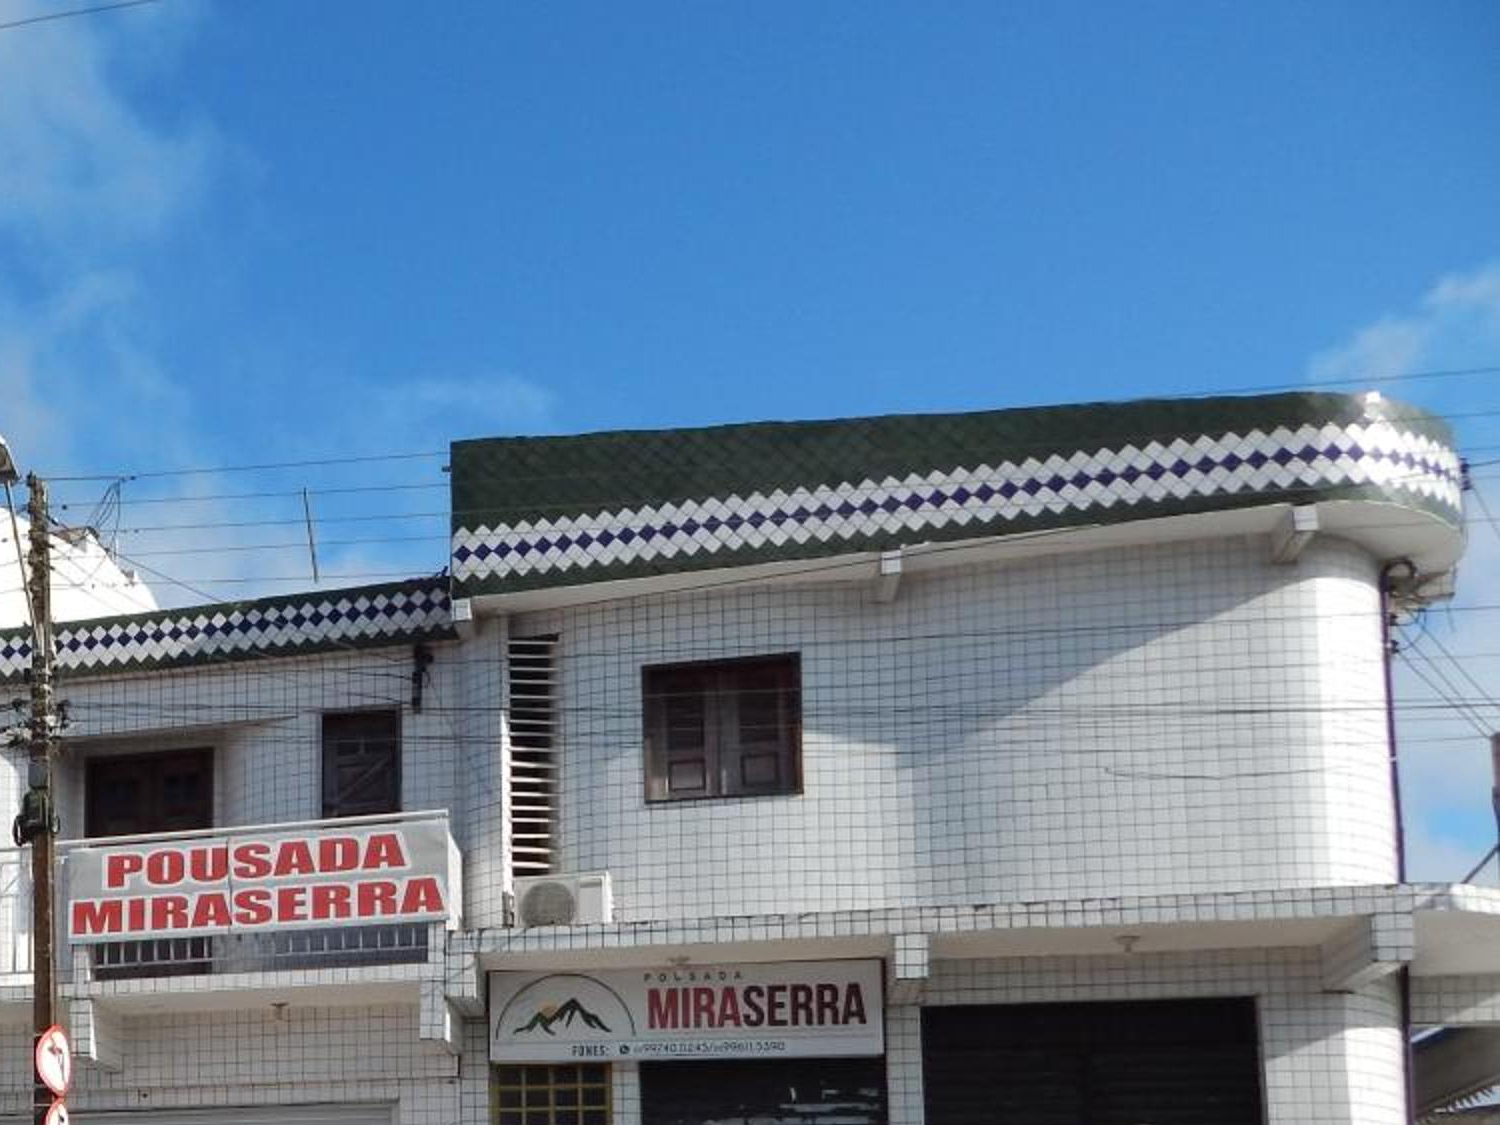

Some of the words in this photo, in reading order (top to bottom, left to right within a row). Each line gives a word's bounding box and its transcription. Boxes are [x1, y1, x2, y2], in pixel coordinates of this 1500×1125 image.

[107, 834, 405, 888] POUSADA
[72, 877, 444, 935] MIRASERRA
[647, 983, 867, 1029] MIRASERRA
